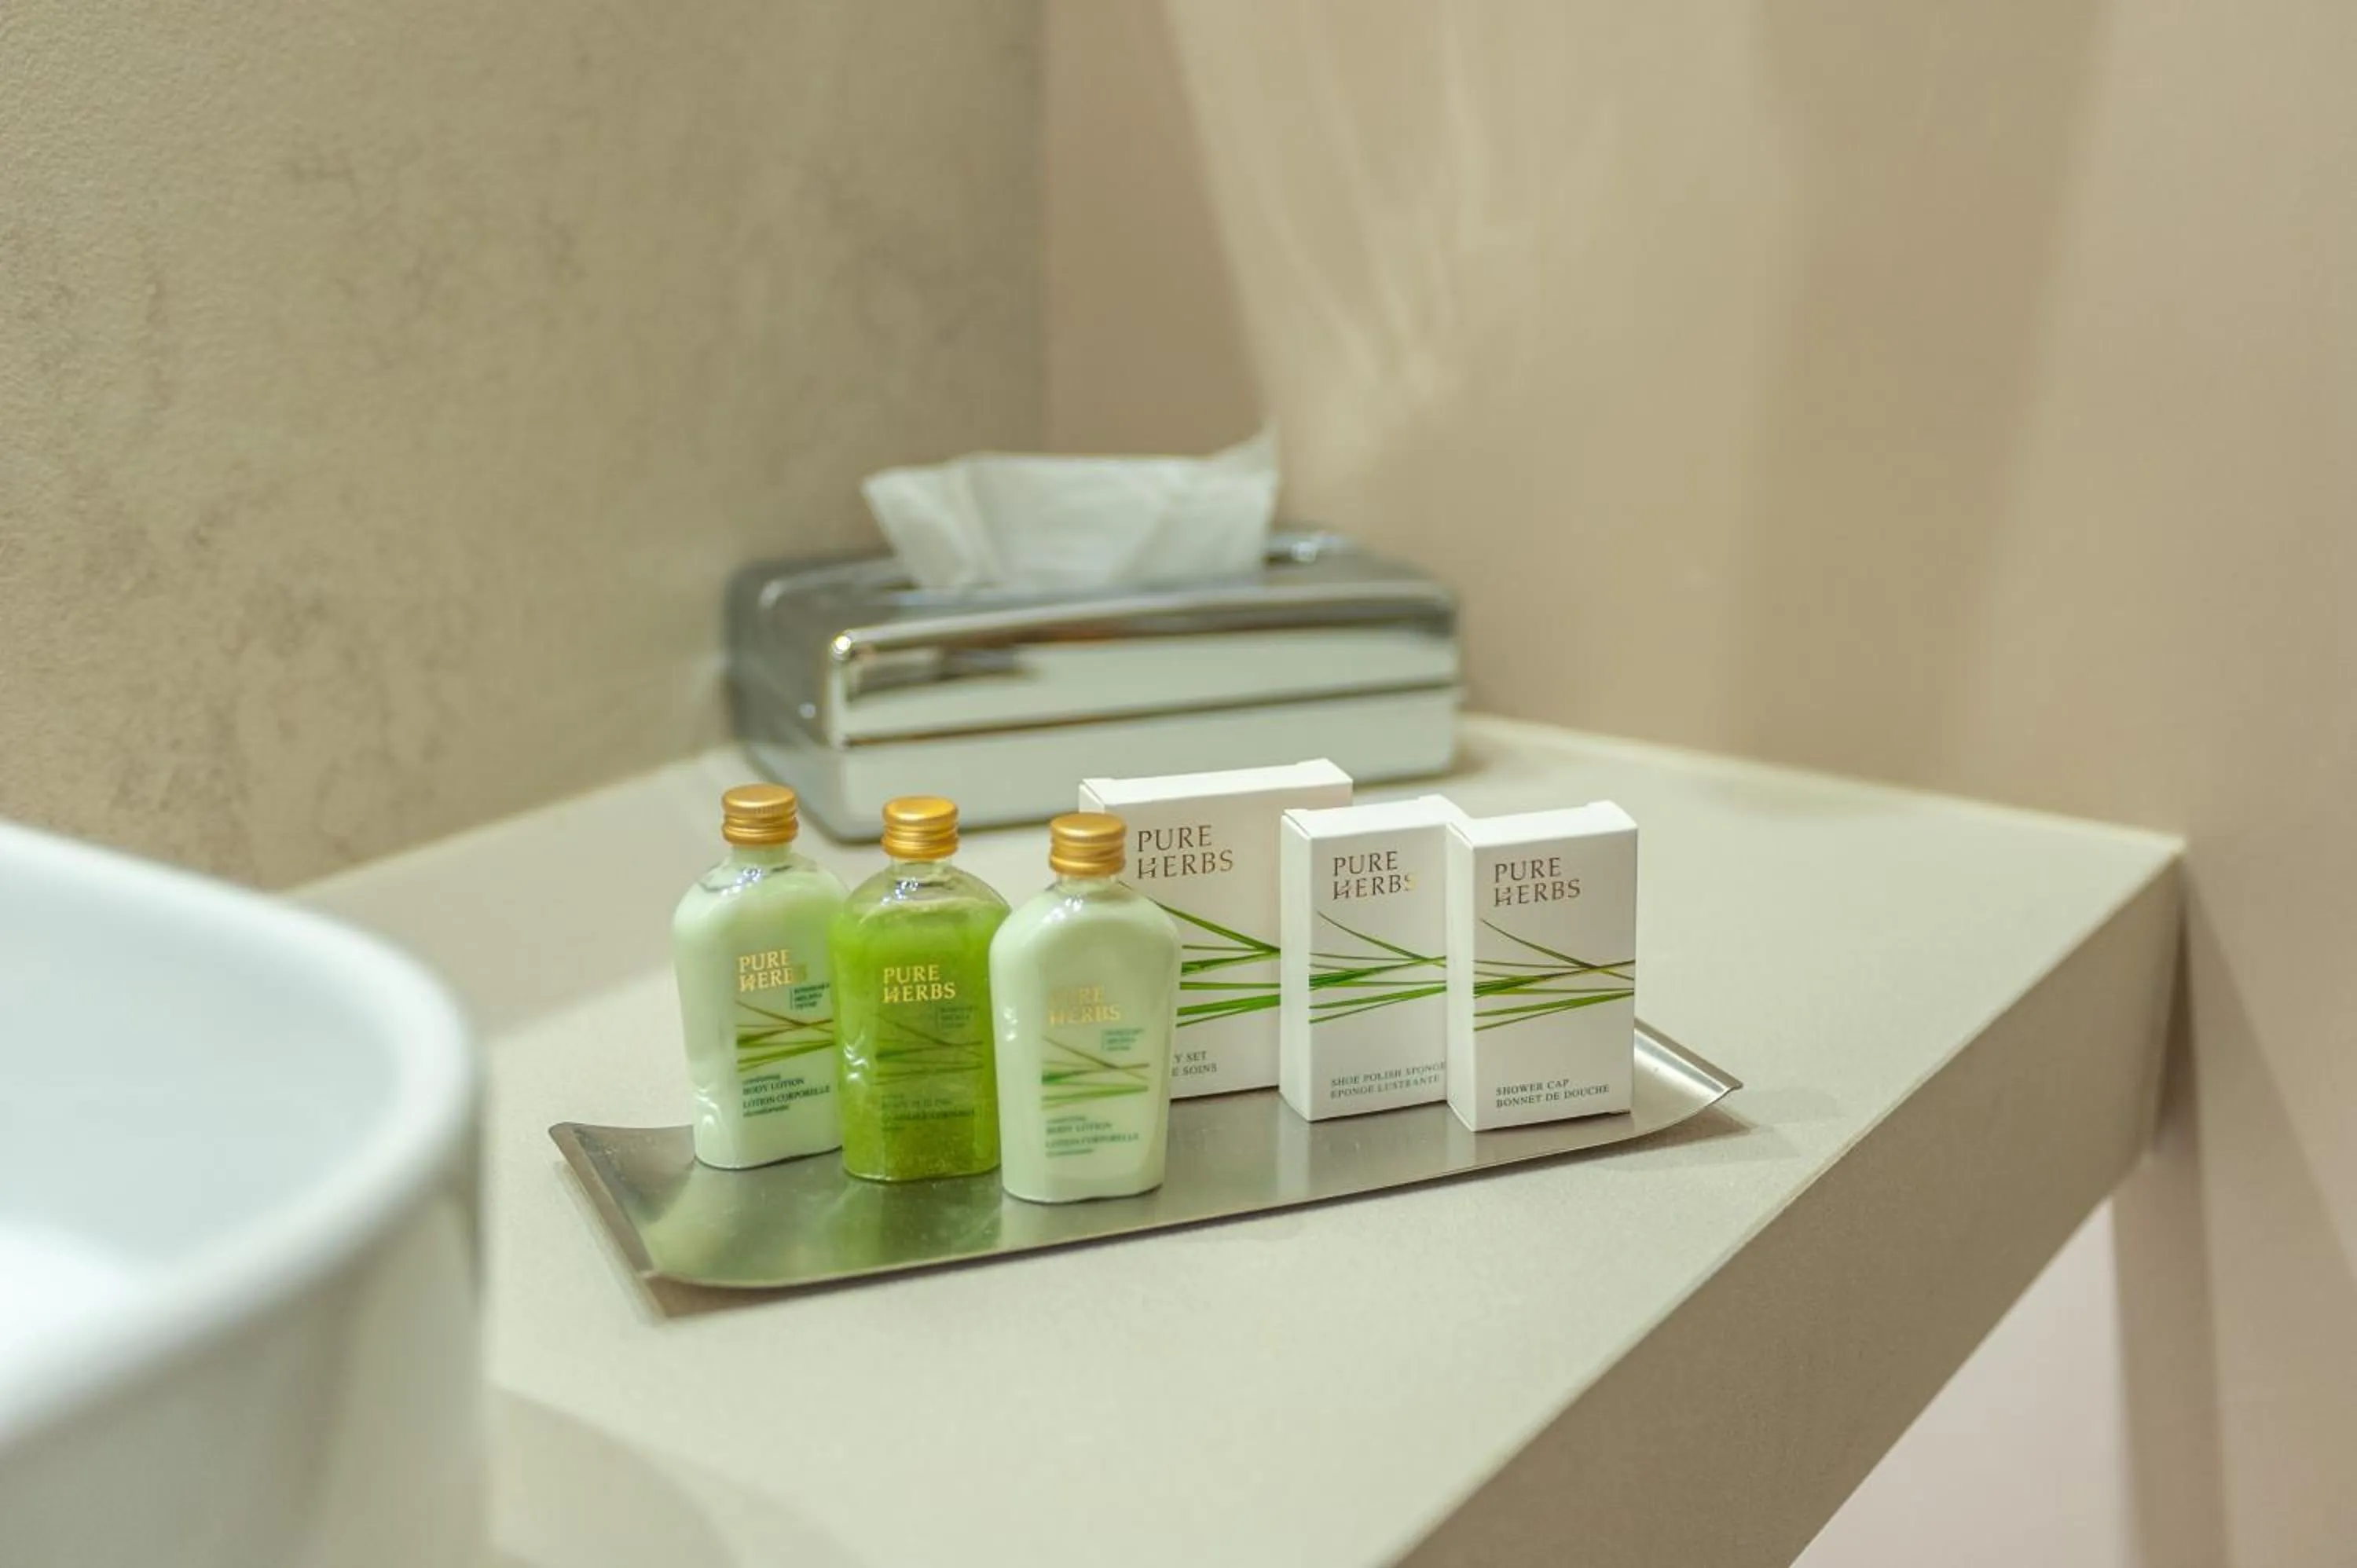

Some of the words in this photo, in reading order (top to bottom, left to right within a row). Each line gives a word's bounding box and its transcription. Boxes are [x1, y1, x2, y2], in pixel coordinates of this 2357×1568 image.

[1137, 824, 1212, 852] PURE
[1137, 848, 1234, 879] HERBS
[1332, 851, 1398, 877] PURE
[1494, 857, 1562, 884] PURE
[1332, 873, 1417, 900] HERBS
[1494, 877, 1582, 907] HERBS
[739, 948, 790, 974] PURE
[883, 964, 941, 984] PURE
[882, 981, 957, 1004] HERBS
[1049, 1002, 1121, 1026] HERBS
[1186, 1050, 1208, 1063] SET
[1332, 1075, 1361, 1086] SHOE
[1363, 1068, 1402, 1083] POLISH
[1495, 1081, 1545, 1097] SHOWER
[1546, 1078, 1571, 1090] CAP
[1495, 1093, 1544, 1108] BONNET
[1545, 1091, 1560, 1102] DE
[1563, 1083, 1610, 1101] DOUCHE
